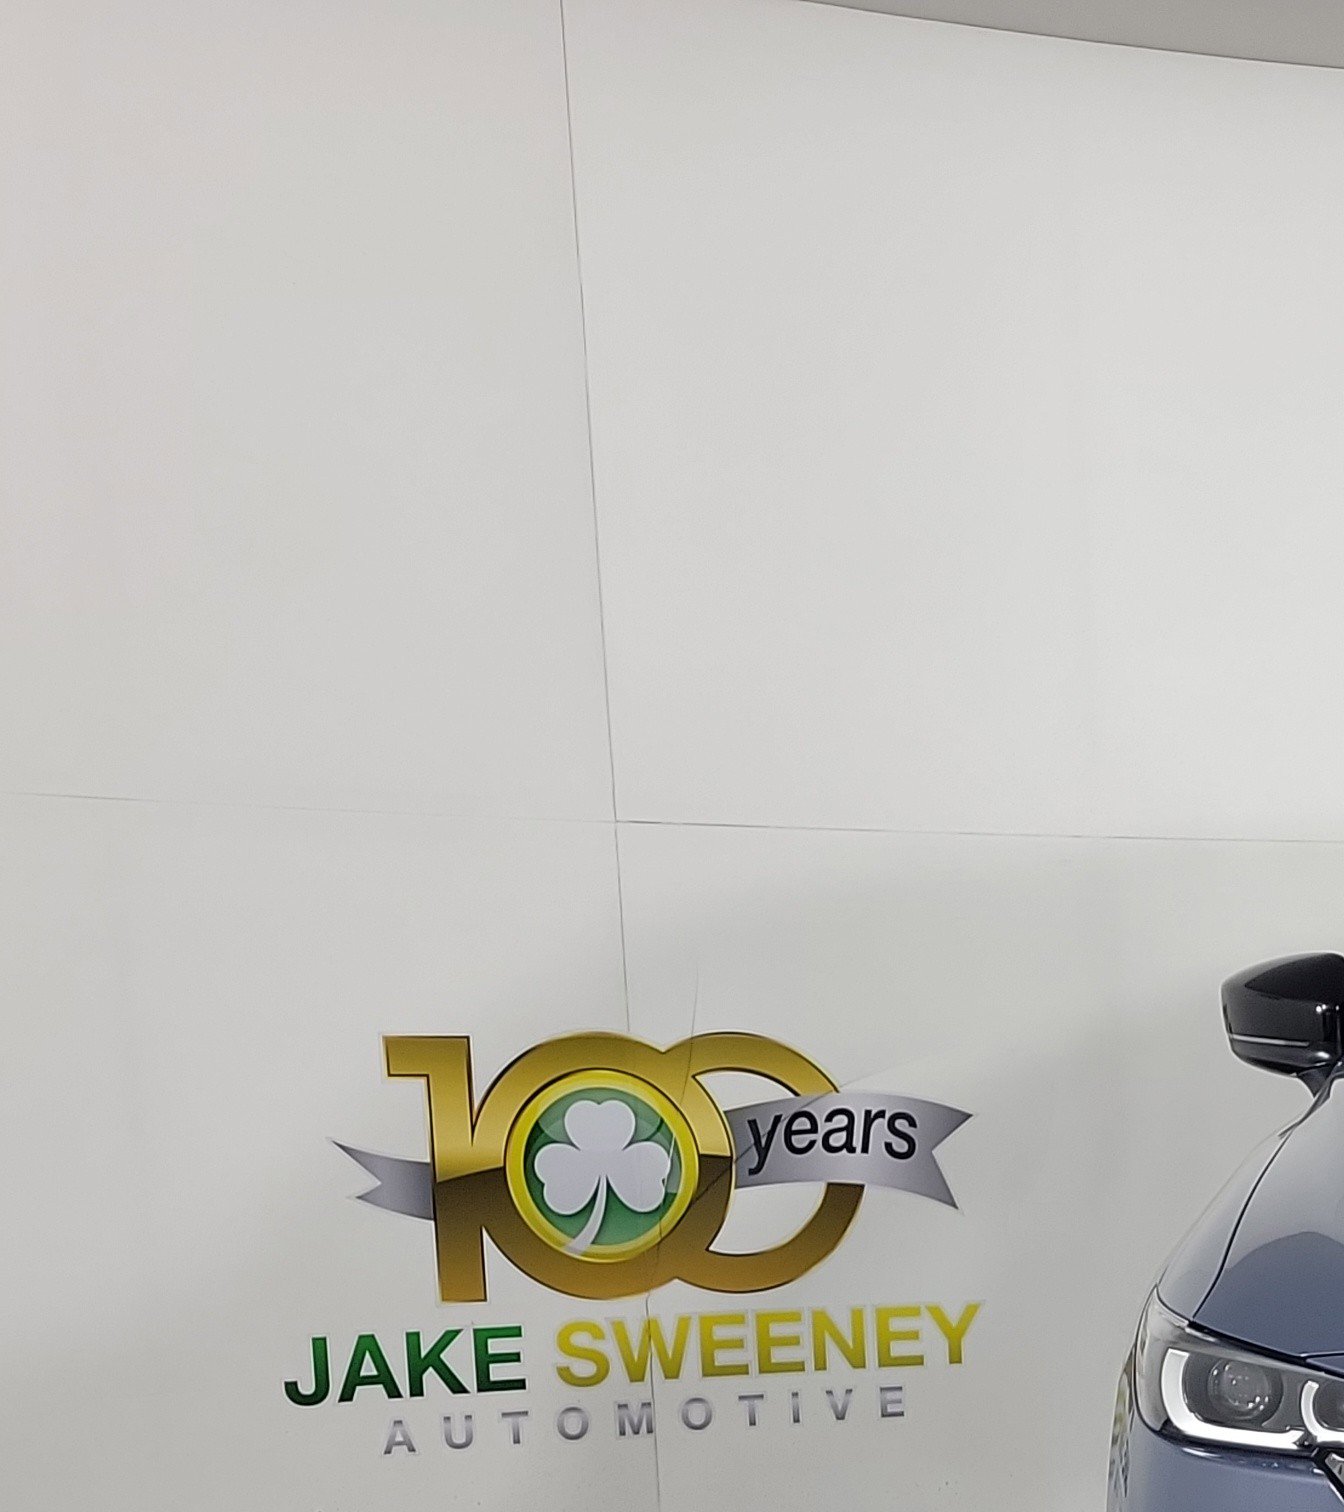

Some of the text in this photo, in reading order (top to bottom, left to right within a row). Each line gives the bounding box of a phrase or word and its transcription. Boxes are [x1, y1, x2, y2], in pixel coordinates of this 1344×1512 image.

[382, 1031, 918, 1303] 100 years
[284, 1303, 981, 1406] JAKE SWEENEY
[383, 1386, 906, 1456] AUTOMOTIVE
